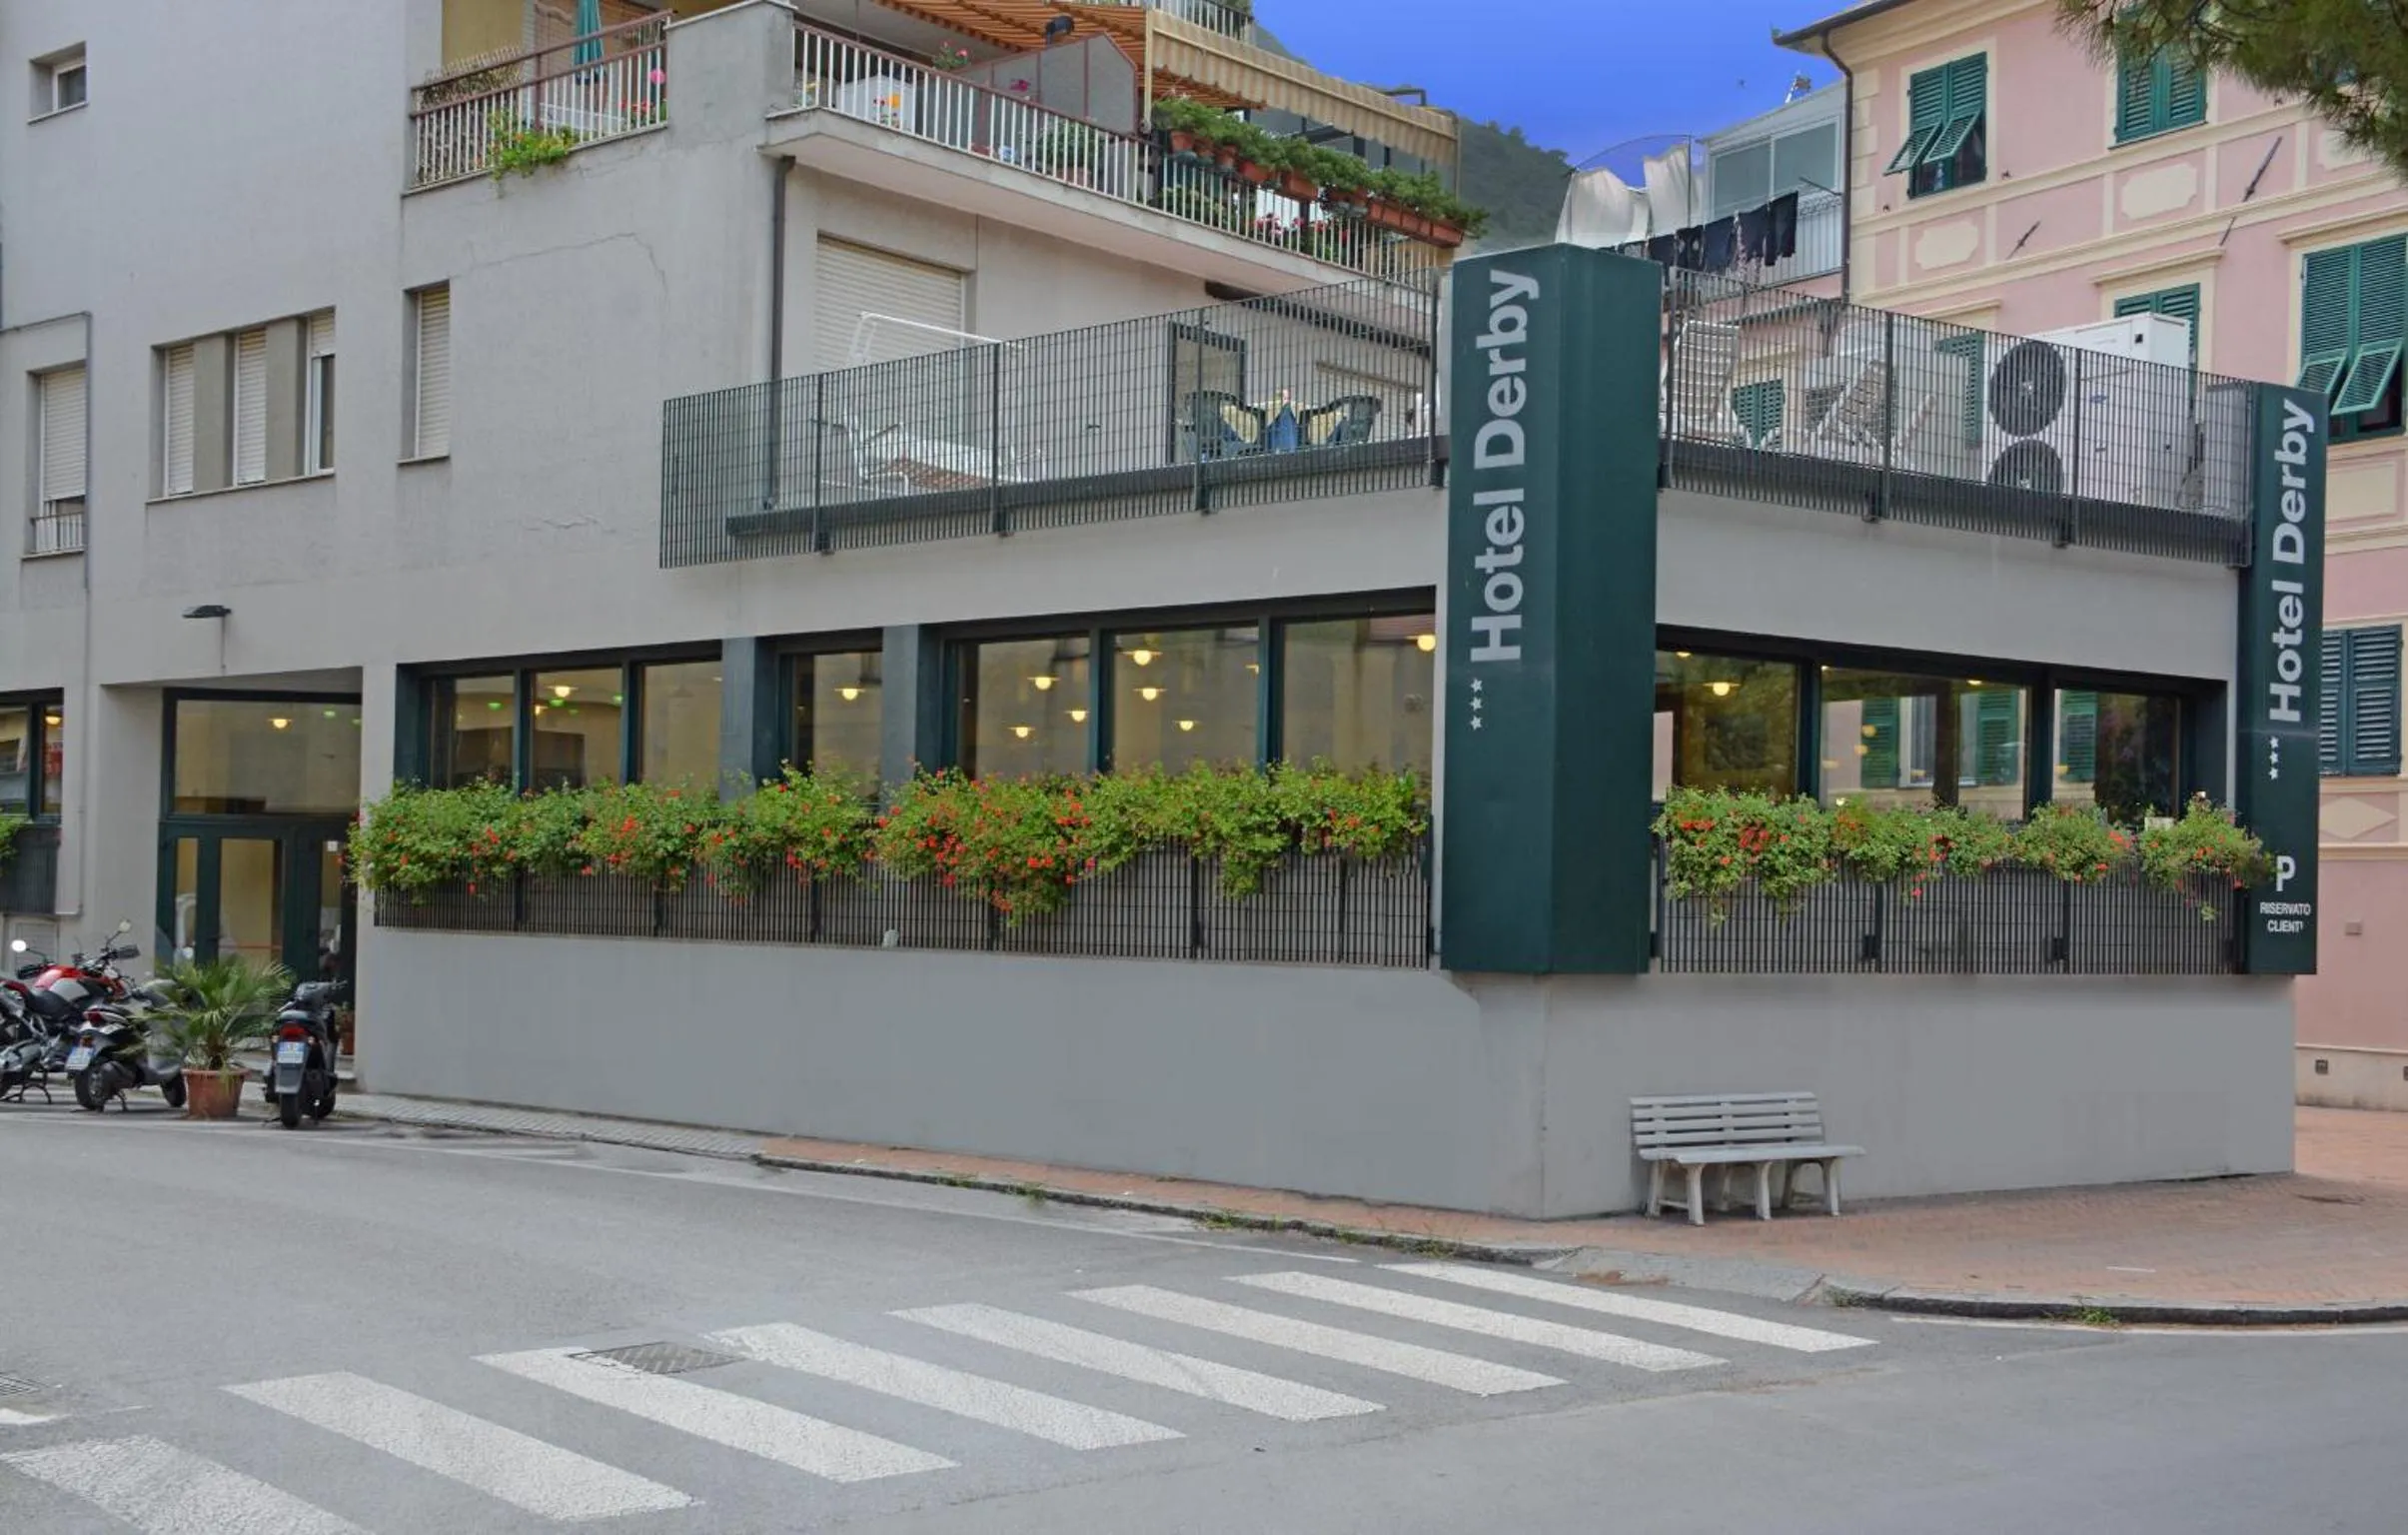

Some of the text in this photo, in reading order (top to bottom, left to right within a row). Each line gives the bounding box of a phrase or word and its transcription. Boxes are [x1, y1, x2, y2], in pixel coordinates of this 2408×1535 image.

[1470, 269, 1540, 663] Hotel Derby
[2269, 399, 2315, 723] Hotel Derby
[2260, 901, 2311, 915] RISERVATO
[2276, 854, 2296, 891] P
